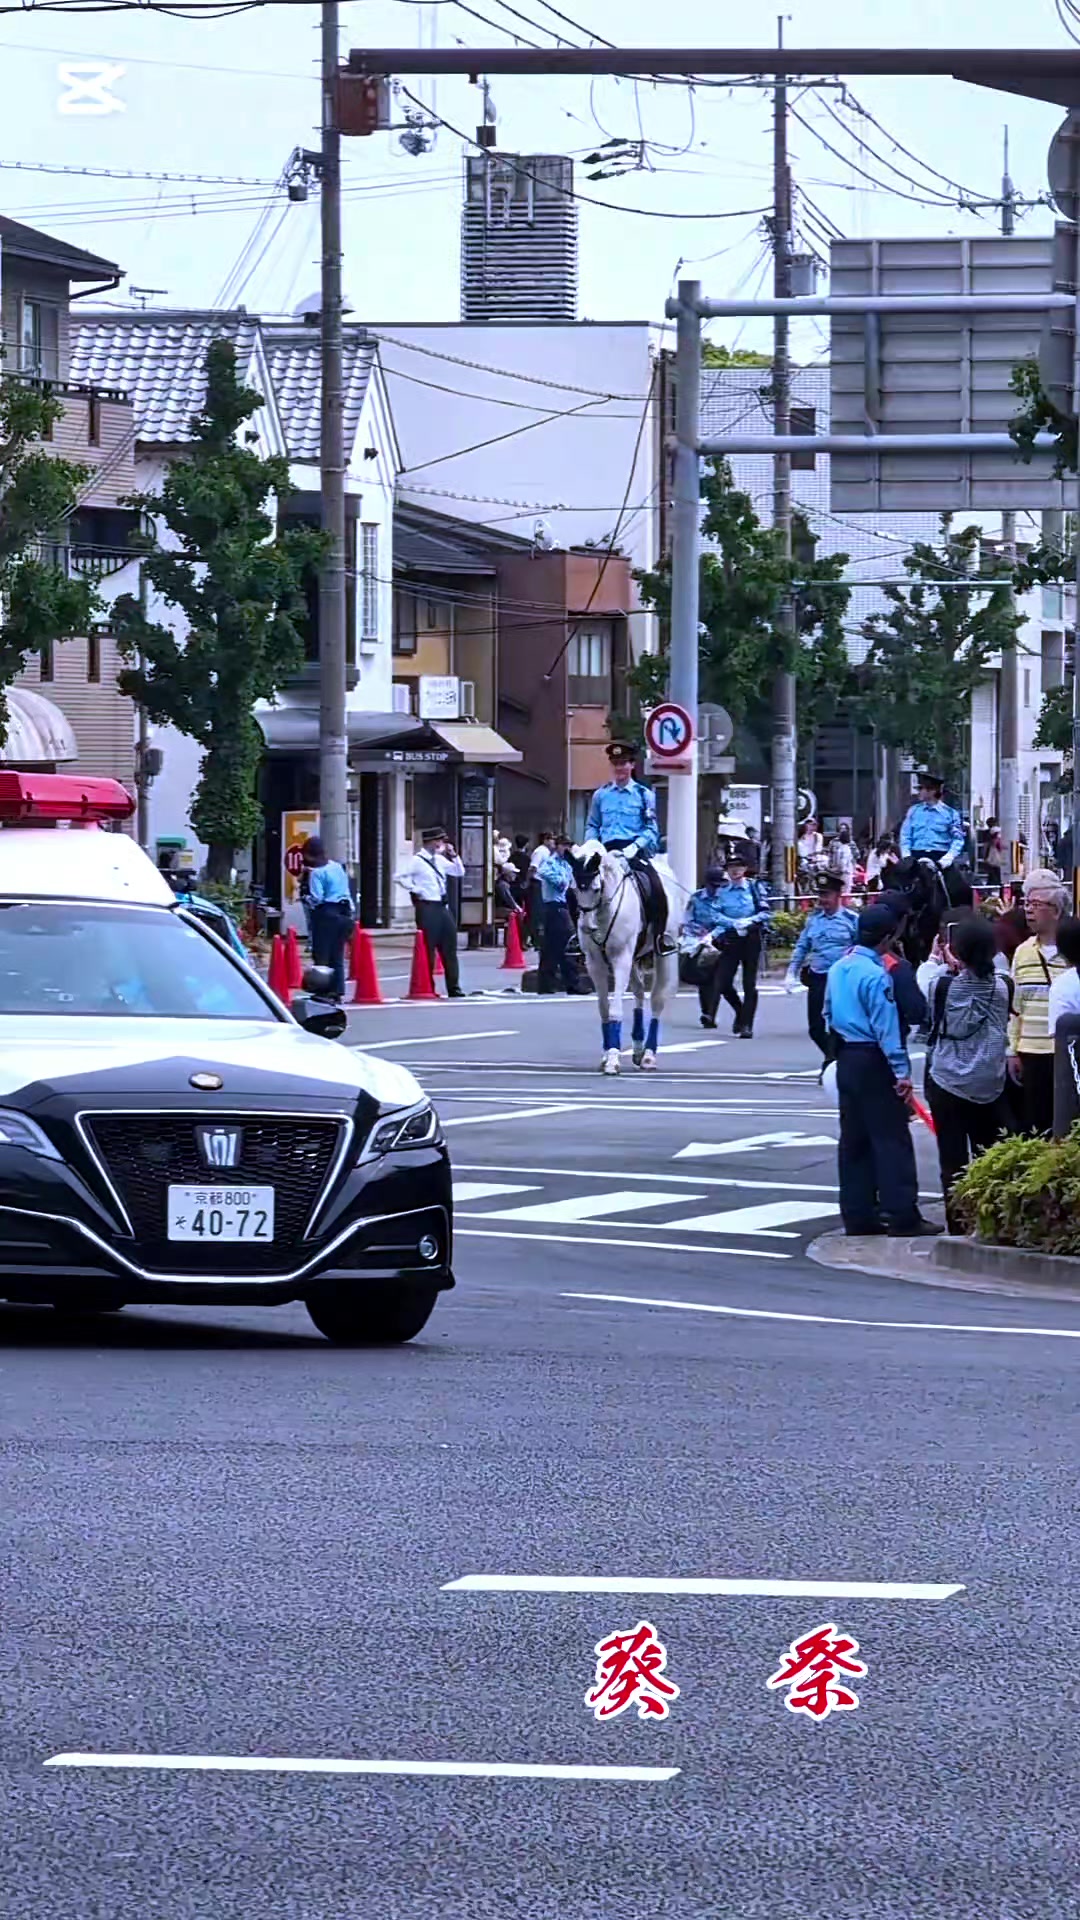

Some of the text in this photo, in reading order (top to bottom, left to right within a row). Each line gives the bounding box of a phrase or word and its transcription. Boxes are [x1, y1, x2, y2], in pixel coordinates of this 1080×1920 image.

[405, 752, 448, 761] BUS STOP
[191, 1208, 268, 1237] 40-72
